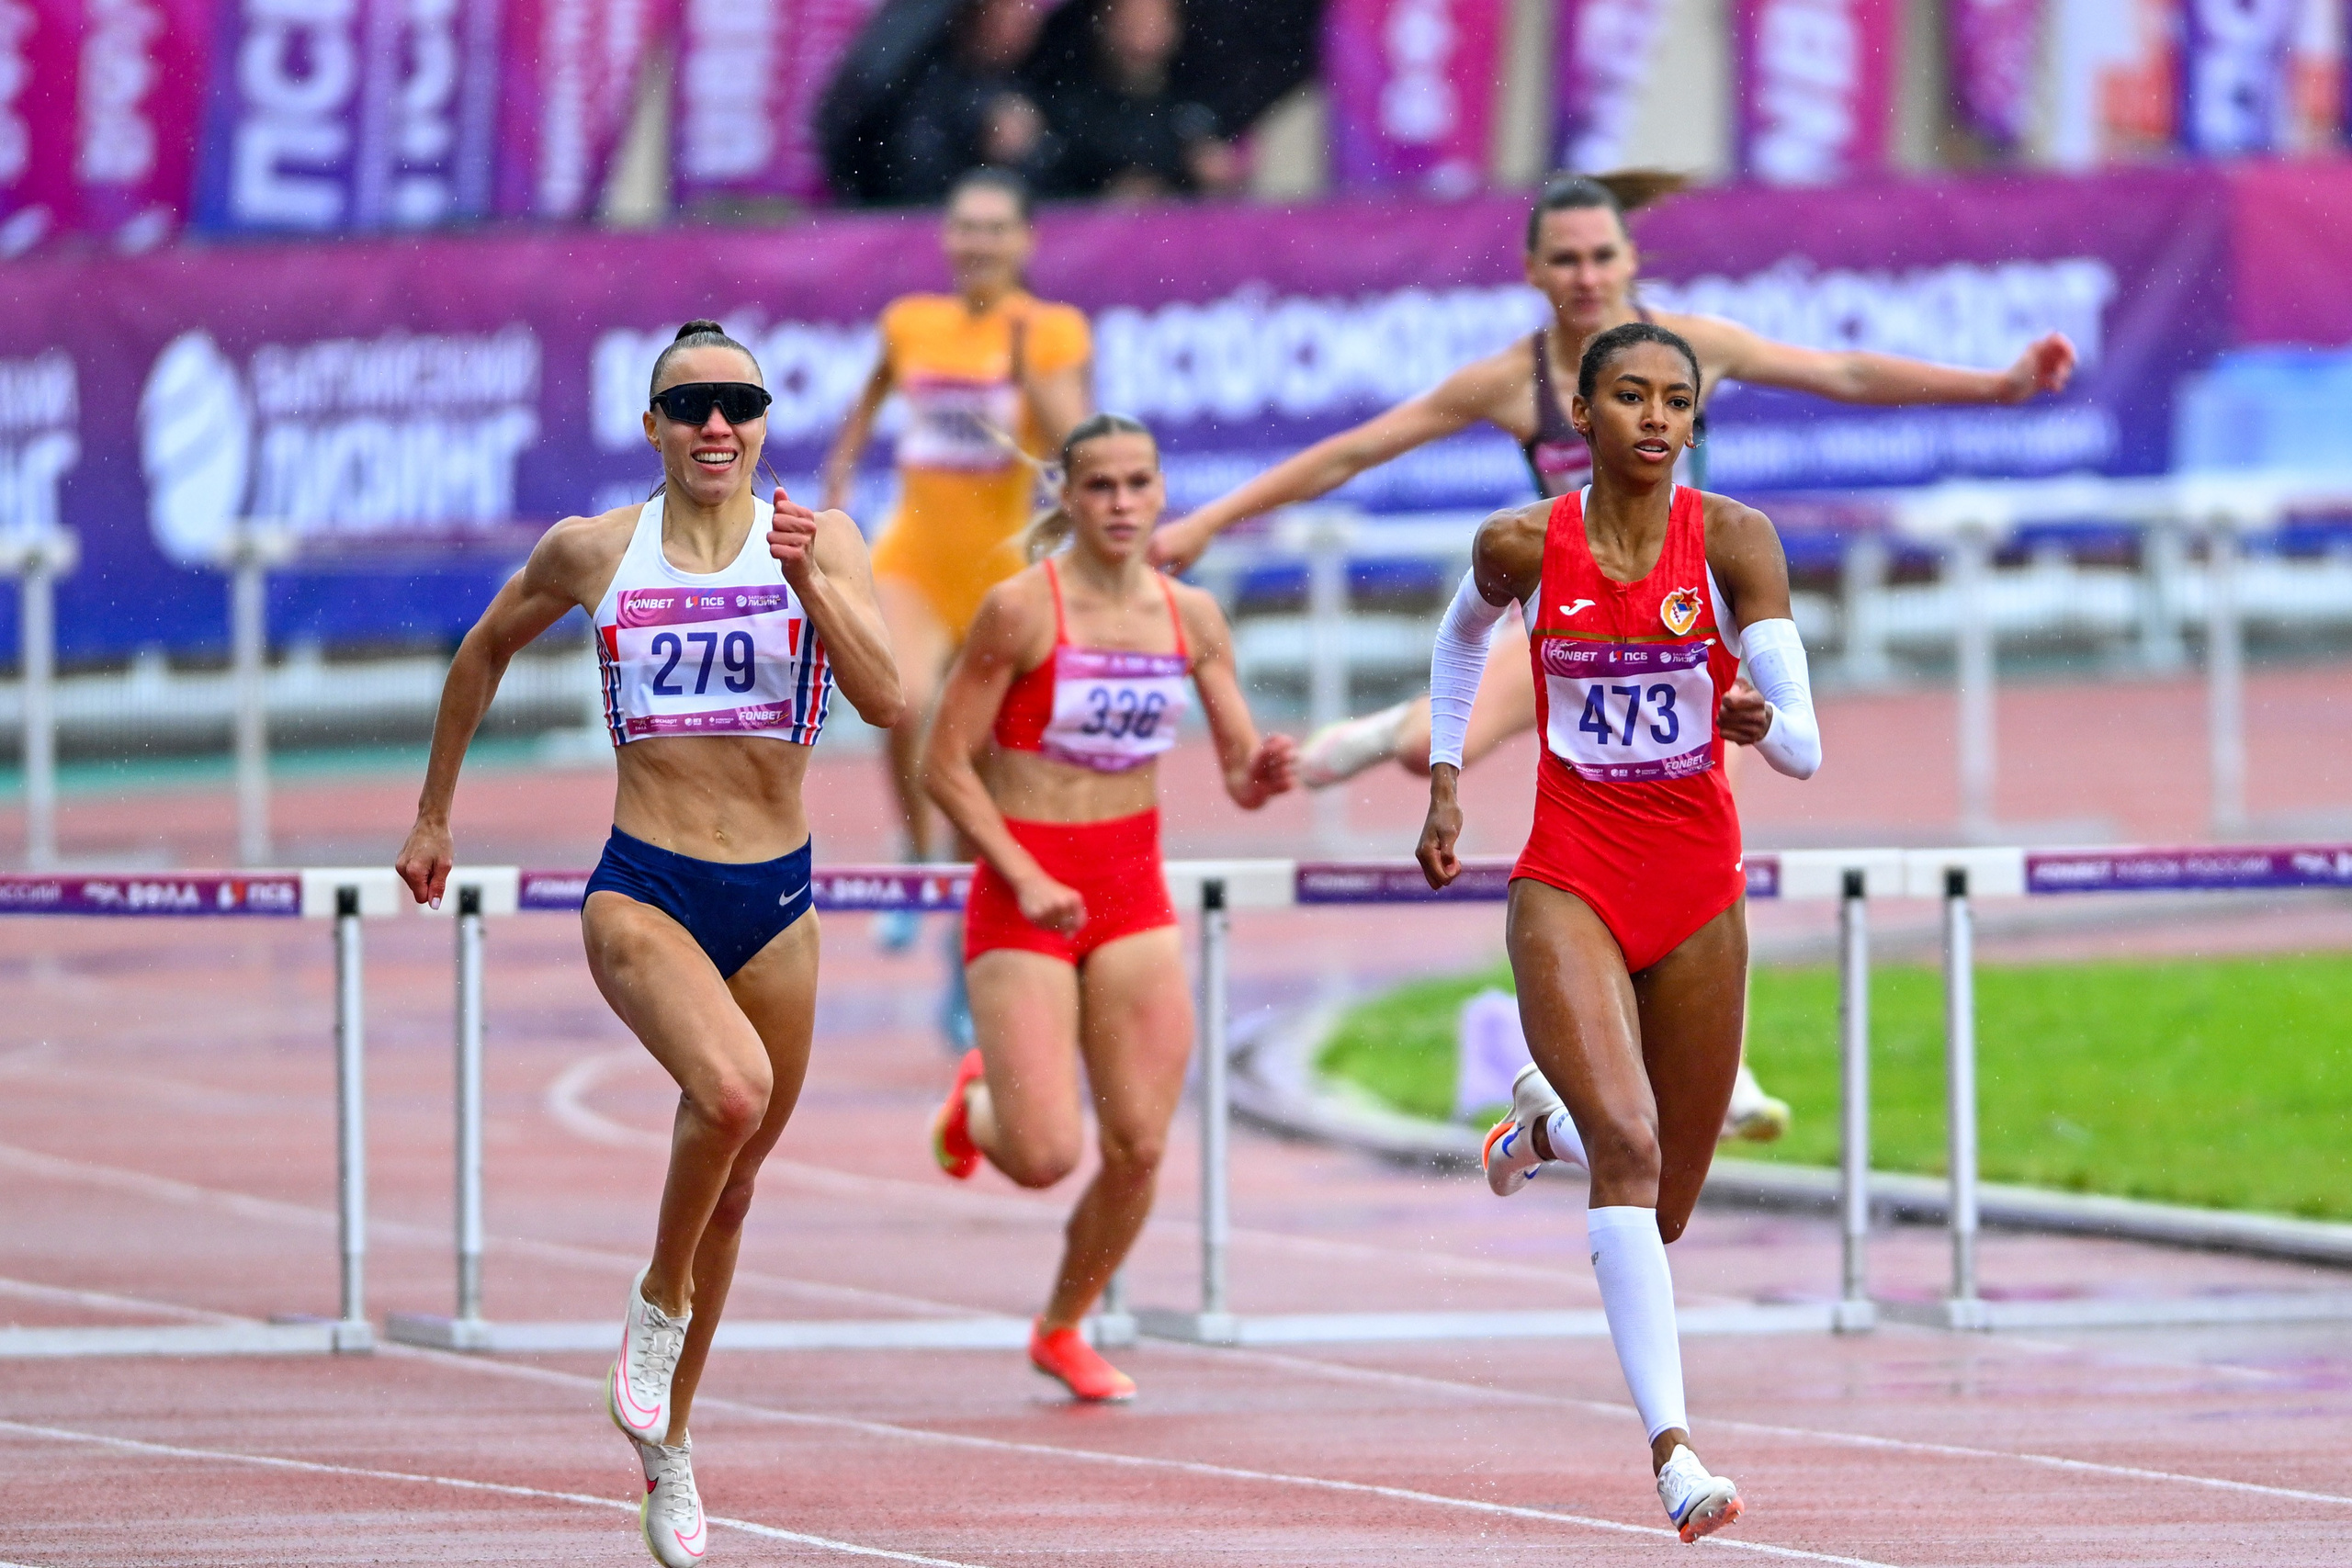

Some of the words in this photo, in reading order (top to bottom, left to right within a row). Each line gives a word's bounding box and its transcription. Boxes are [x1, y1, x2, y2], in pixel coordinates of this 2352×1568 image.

[235, 0, 351, 222] ПС
[627, 599, 674, 609] FONBET
[701, 597, 724, 606] ПСБ
[1550, 649, 1598, 661] FONBET
[1624, 652, 1647, 660] ПСБ
[651, 631, 755, 695] 279
[738, 710, 783, 720] FONBET
[1081, 687, 1166, 739] 336
[1579, 683, 1679, 746] 473
[1666, 754, 1704, 771] FONBET
